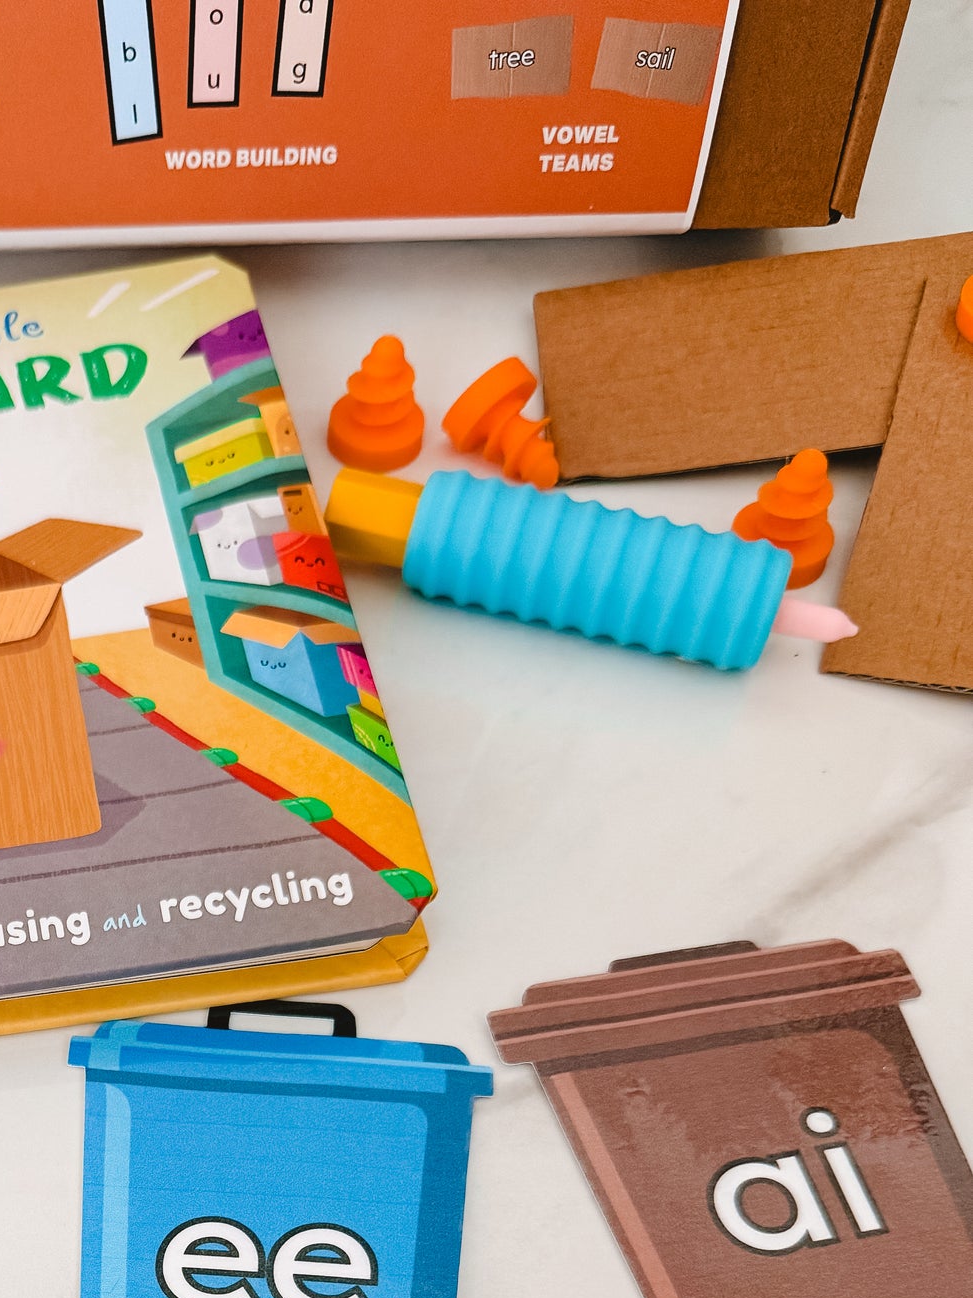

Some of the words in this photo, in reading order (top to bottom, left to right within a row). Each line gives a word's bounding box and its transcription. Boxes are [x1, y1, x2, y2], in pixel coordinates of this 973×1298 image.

[210, 9, 223, 25] o
[122, 42, 137, 63] b
[488, 47, 535, 70] tree
[636, 46, 676, 71] sail
[208, 73, 220, 89] u
[292, 62, 307, 84] g
[542, 125, 619, 145] VOWEL
[165, 149, 231, 170] WORD
[236, 146, 338, 168] BUILDING
[539, 153, 614, 173] TEAMS
[103, 905, 146, 932] and
[160, 871, 353, 922] recycling
[707, 1106, 889, 1257] ai
